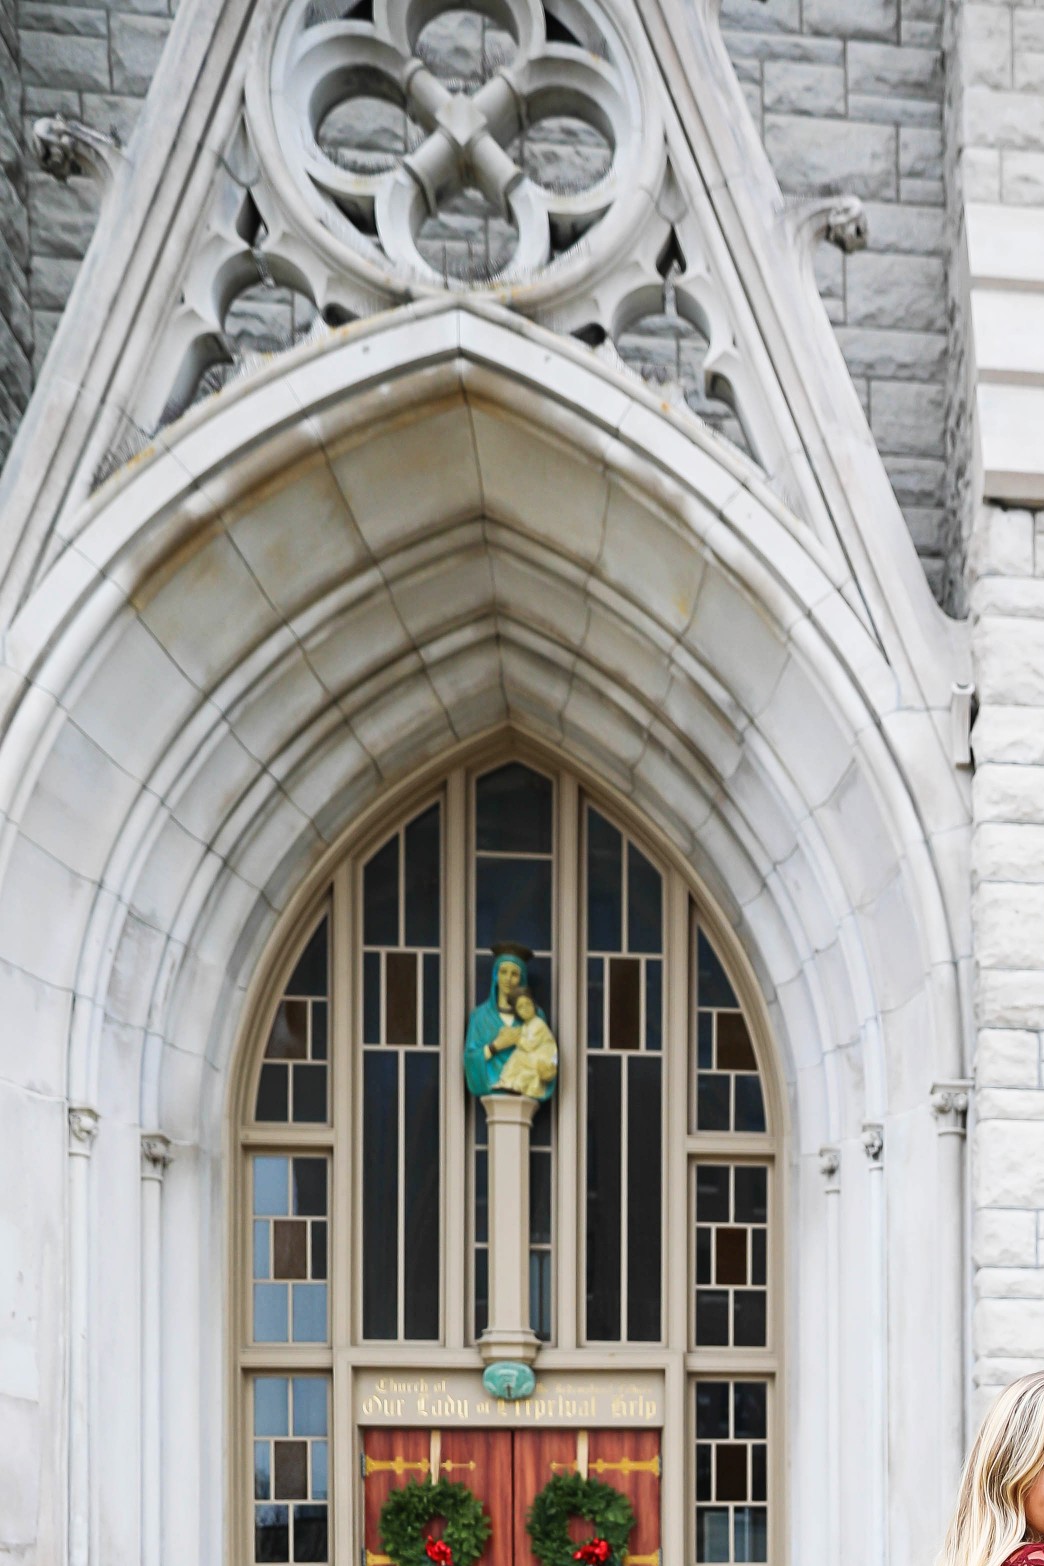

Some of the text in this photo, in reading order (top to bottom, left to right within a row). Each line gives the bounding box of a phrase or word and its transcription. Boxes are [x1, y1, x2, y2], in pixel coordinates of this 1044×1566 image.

[375, 1378, 447, 1394] Church of
[362, 1394, 405, 1417] Our
[417, 1394, 469, 1419] Lady
[476, 1399, 491, 1415] of
[611, 1394, 657, 1420] Help
